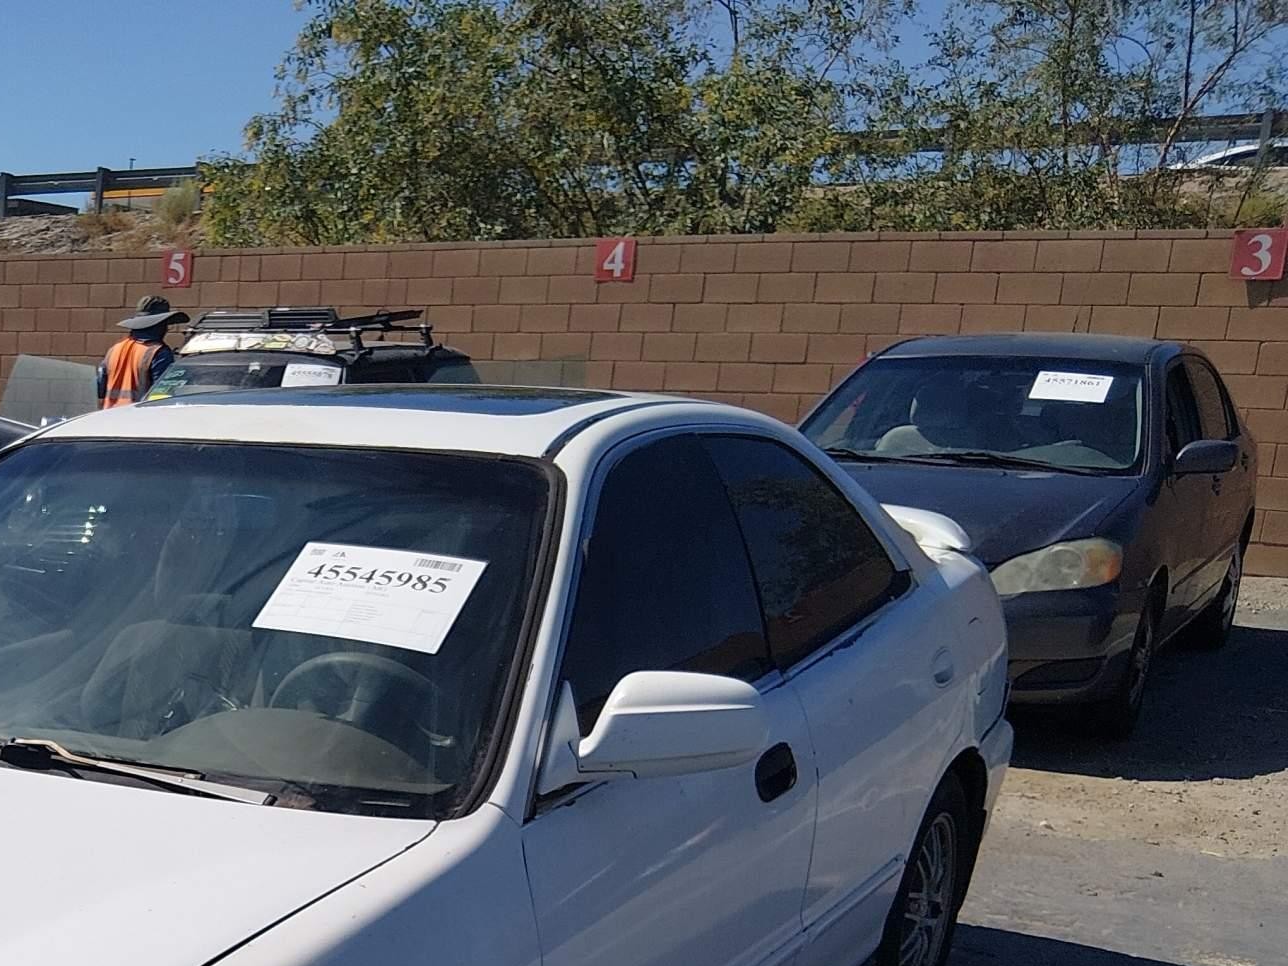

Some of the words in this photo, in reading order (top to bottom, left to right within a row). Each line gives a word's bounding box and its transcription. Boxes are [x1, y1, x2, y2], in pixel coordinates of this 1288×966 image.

[167, 252, 185, 284] 5
[602, 241, 625, 277] 4
[1240, 233, 1273, 276] 3
[306, 562, 453, 595] 45545985
